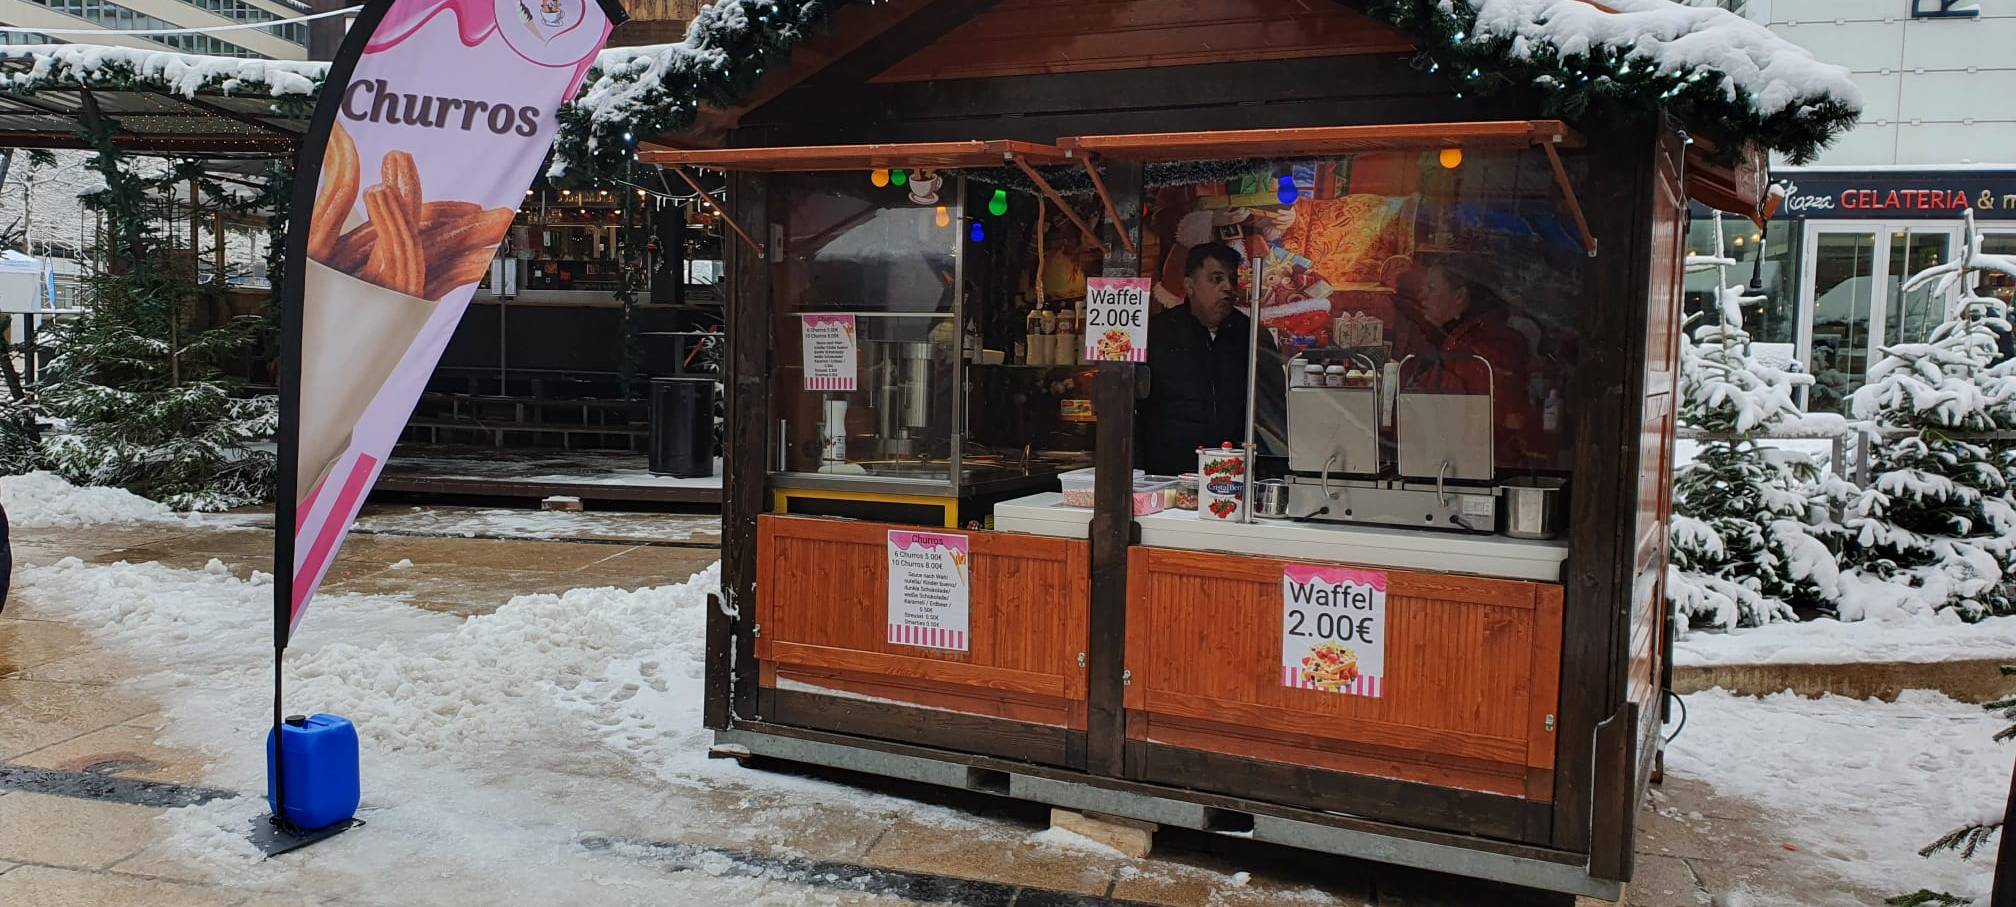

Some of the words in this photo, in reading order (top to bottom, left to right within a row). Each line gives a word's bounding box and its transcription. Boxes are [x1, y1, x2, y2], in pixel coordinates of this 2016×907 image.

[341, 78, 540, 137] Churros
[1784, 182, 1835, 213] Piazza
[1840, 189, 1969, 209] GELATERIA
[1977, 189, 1994, 209] &
[1091, 289, 1142, 305] Waffel
[1089, 308, 1142, 327] 2.00€
[912, 534, 944, 545] Churros
[900, 551, 923, 559] Churros
[925, 553, 942, 561] 5.00€
[900, 560, 924, 568] Churros
[1289, 581, 1373, 611] Waffel
[1288, 609, 1374, 644] 2.00€
